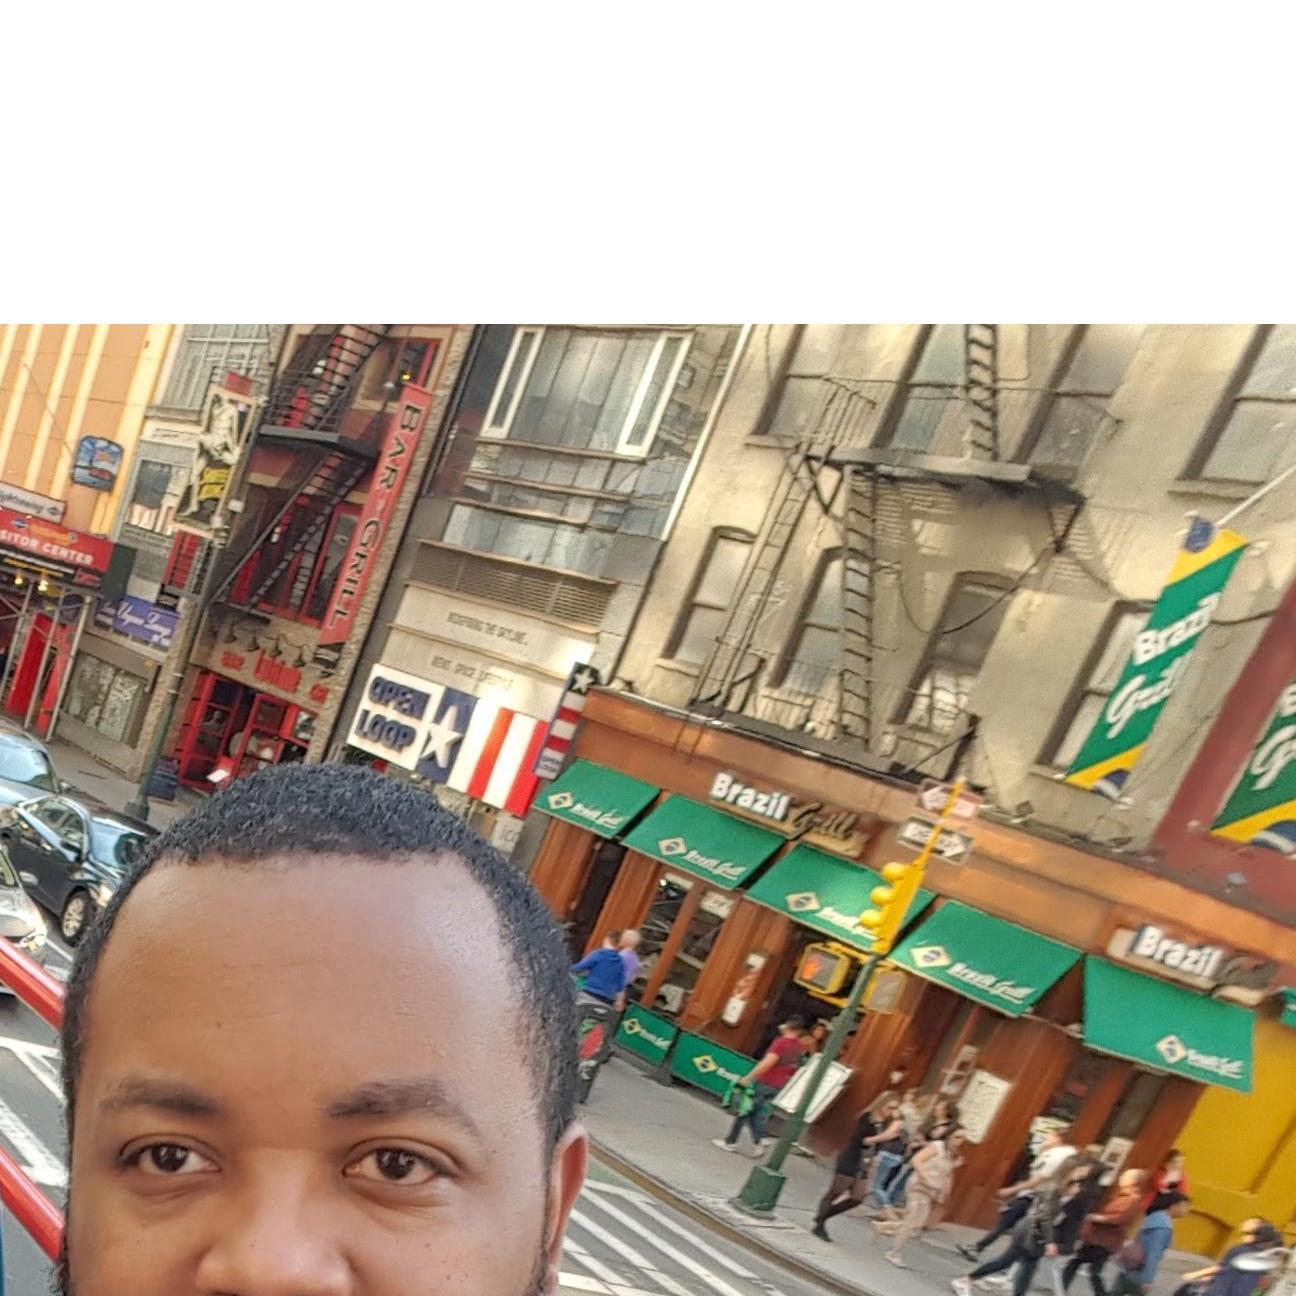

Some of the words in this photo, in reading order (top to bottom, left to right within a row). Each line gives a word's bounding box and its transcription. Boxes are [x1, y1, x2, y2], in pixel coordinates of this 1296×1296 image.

[380, 404, 422, 490] BAR
[42, 543, 94, 566] CENTER
[329, 520, 381, 628] GRILL
[368, 676, 431, 721] OPEN
[354, 709, 417, 754] LOOP
[710, 771, 794, 821] Brazil
[788, 801, 858, 841] Grill
[1132, 925, 1224, 977] Brazil
